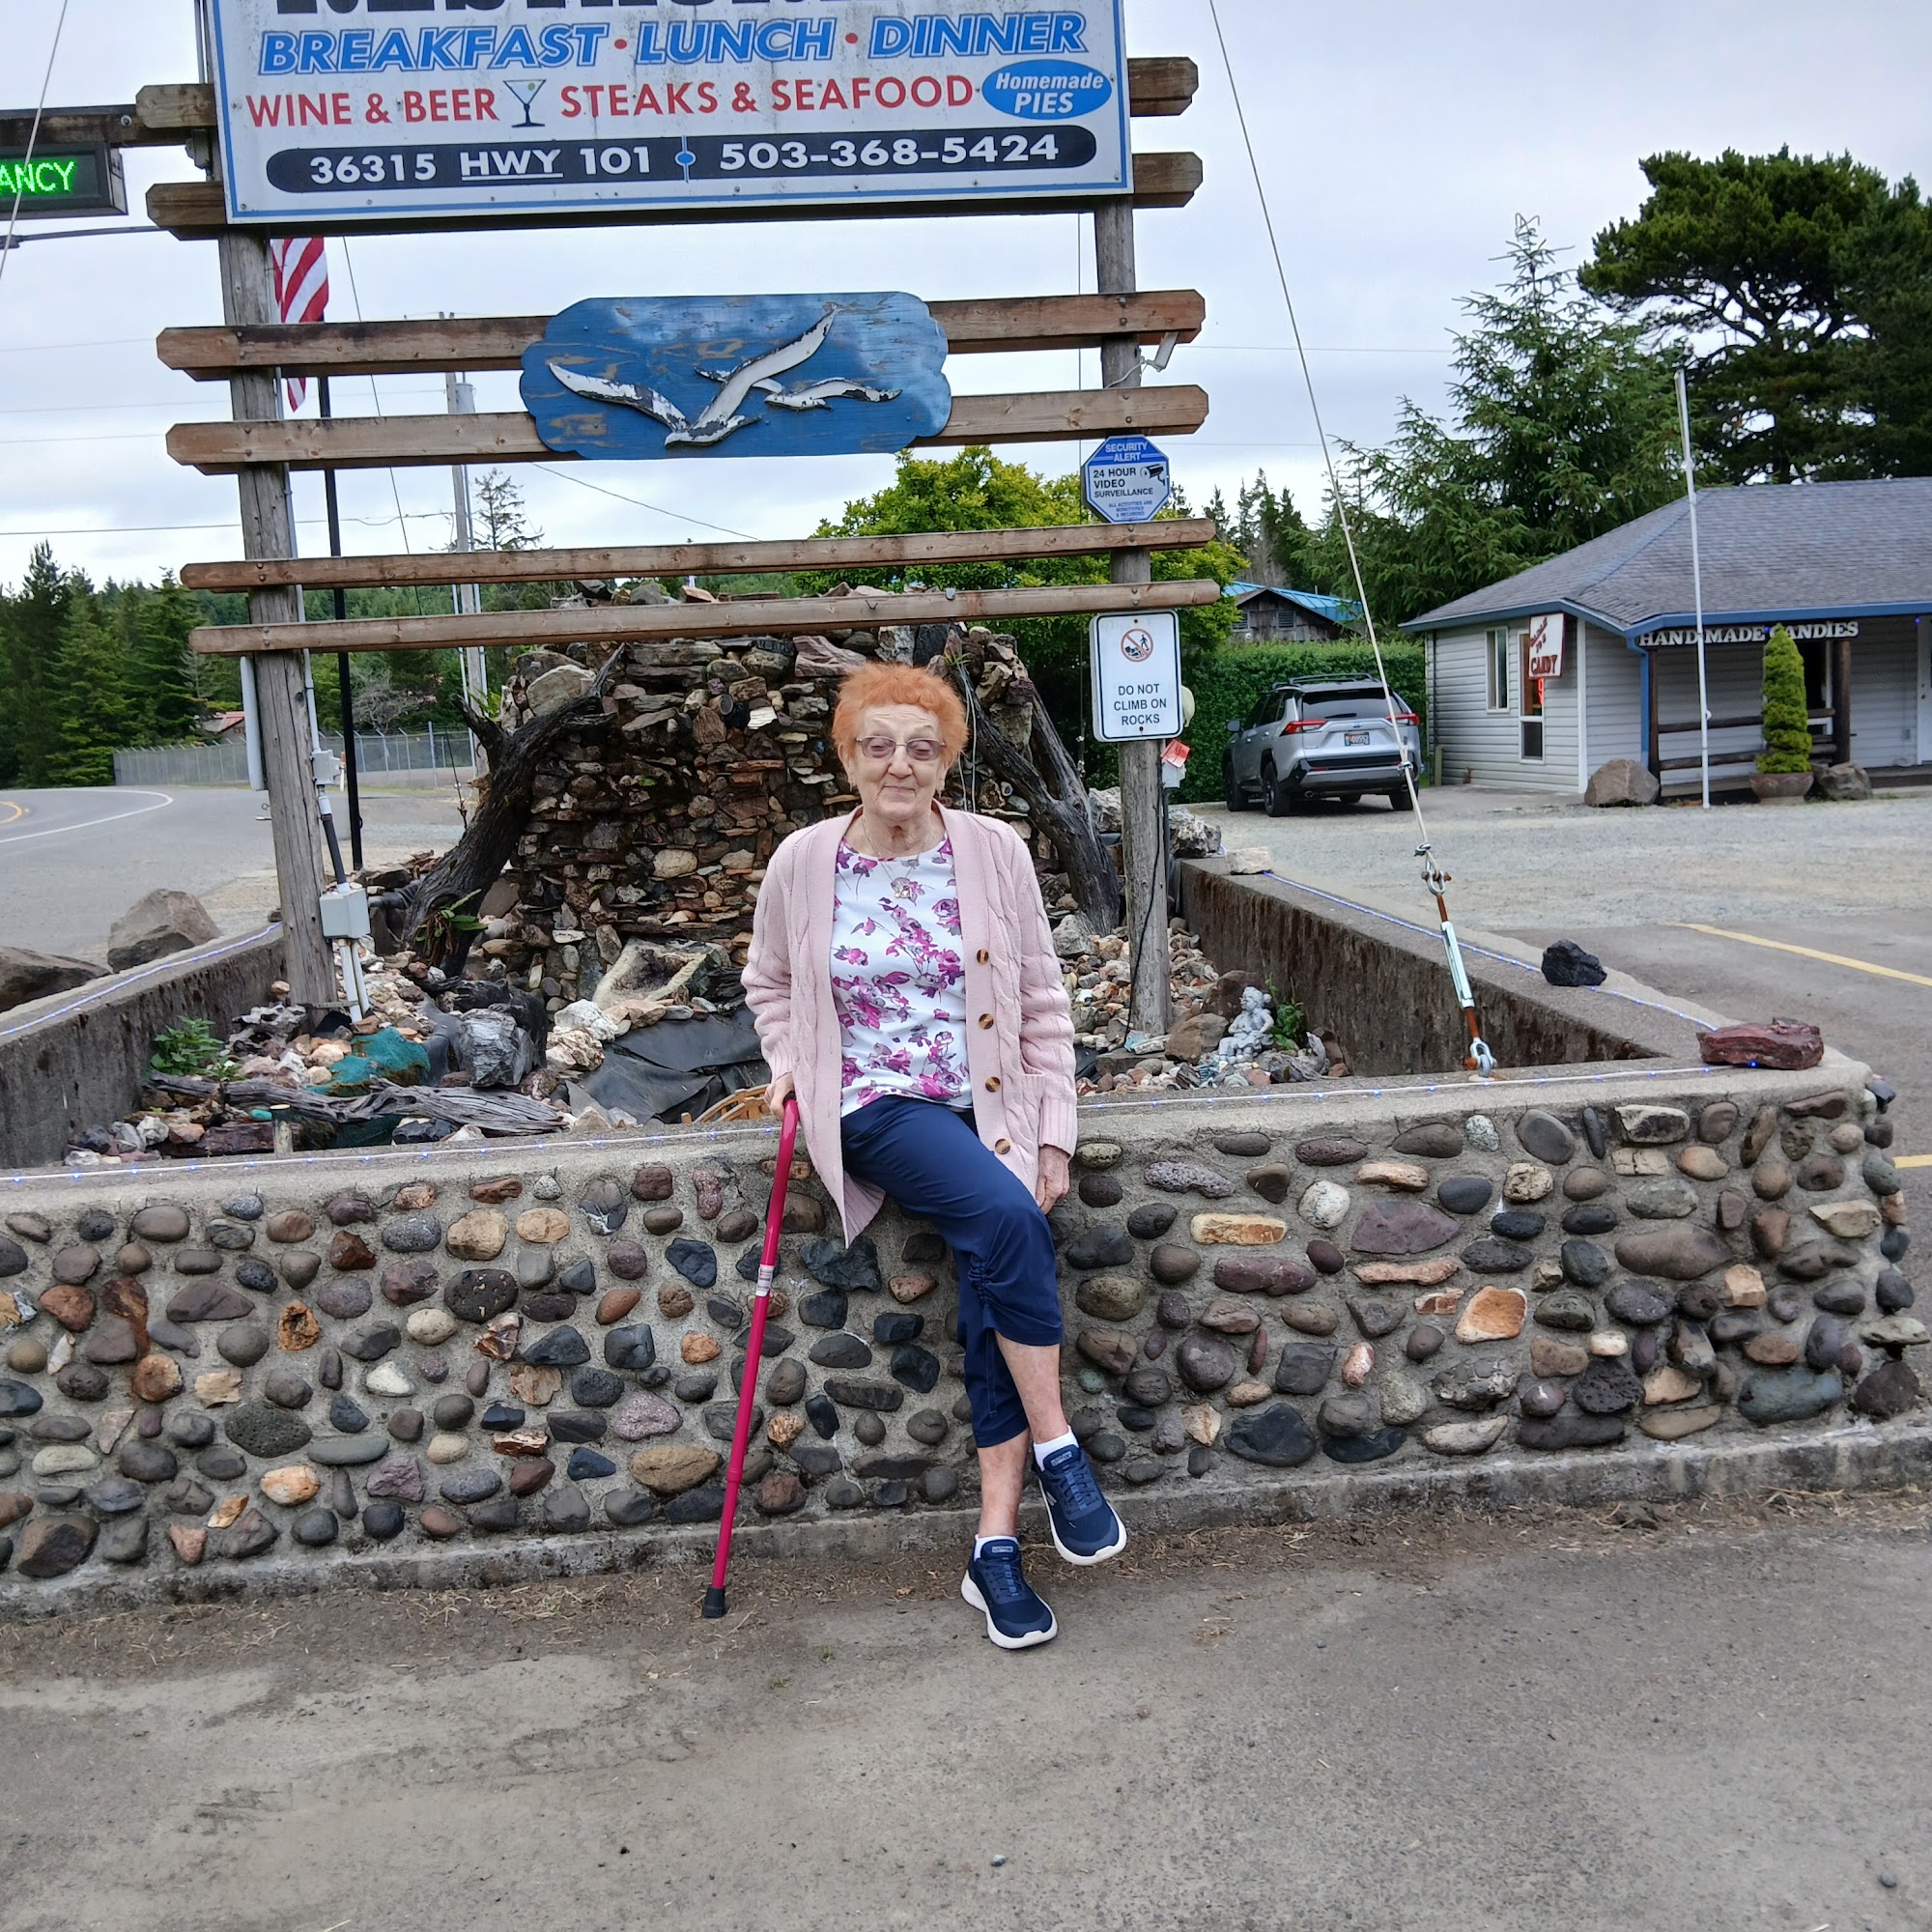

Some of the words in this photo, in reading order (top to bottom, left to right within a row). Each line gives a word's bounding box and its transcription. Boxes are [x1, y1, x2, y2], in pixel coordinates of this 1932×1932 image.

[258, 22, 610, 75] BREAKFAST
[636, 15, 837, 66] LUNCH
[867, 11, 1090, 59] DINNER
[994, 71, 1104, 92] Homemade
[560, 81, 718, 118] STEAKS
[731, 80, 758, 113] &
[772, 74, 974, 111] SEAFOOD
[1013, 92, 1074, 115] PIES
[246, 93, 353, 128] WINE
[365, 93, 390, 124] &
[404, 88, 499, 123] BEER
[720, 133, 1059, 171] 503-368-5424
[310, 153, 437, 185] 36315
[460, 148, 563, 177] HWY
[580, 146, 650, 175] 101
[1105, 442, 1148, 452] SECURITY
[1114, 452, 1141, 462] ALERT
[1094, 469, 1104, 478] 24
[1108, 468, 1136, 476] HOUR
[1093, 479, 1125, 489] VIDEO
[1094, 488, 1153, 498] SURVEILLANCE
[1638, 630, 1700, 646] HAND
[1704, 625, 1766, 643] MADE
[1118, 685, 1134, 696] DO
[1137, 683, 1160, 695] NOT
[1114, 700, 1148, 711] CLIMB
[1151, 698, 1167, 709] ON
[1121, 714, 1160, 725] ROCKS
